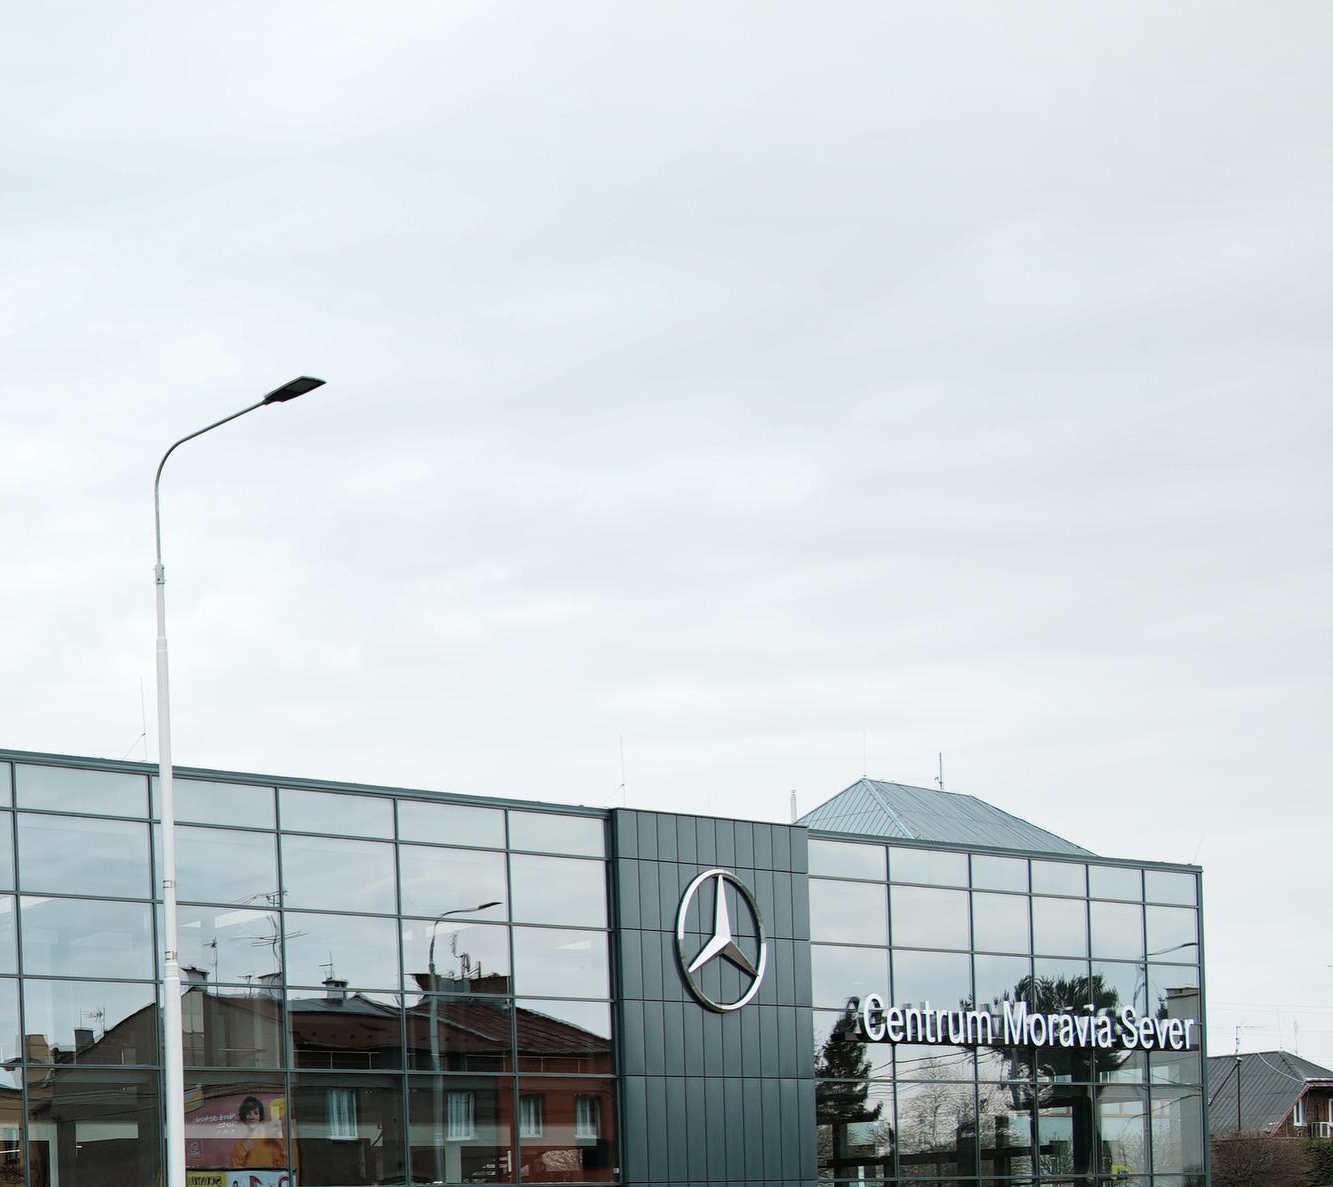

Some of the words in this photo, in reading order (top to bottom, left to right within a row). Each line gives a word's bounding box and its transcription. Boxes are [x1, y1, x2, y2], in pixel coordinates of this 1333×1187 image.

[863, 993, 993, 1044] Centrum
[1003, 1001, 1113, 1048] Moravia
[1121, 1004, 1195, 1050] Sever
